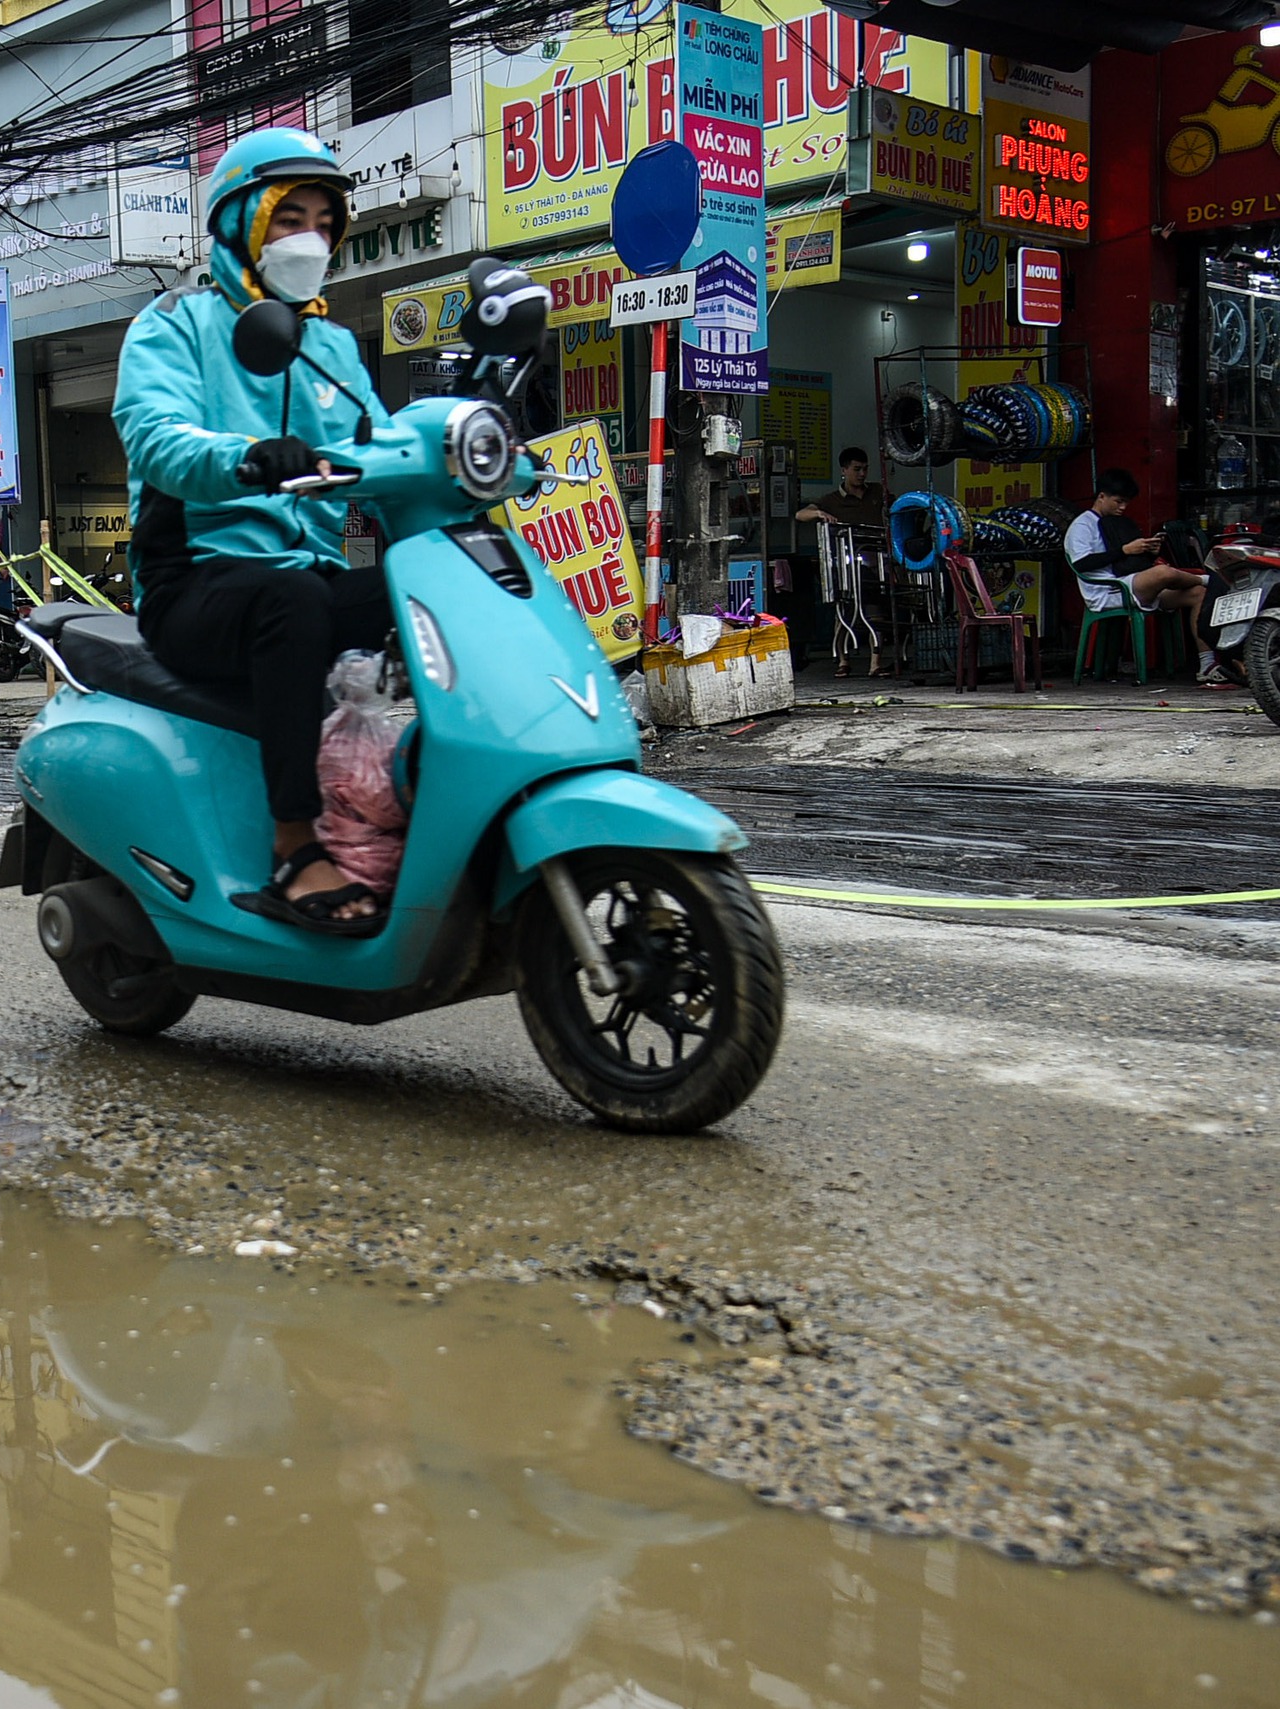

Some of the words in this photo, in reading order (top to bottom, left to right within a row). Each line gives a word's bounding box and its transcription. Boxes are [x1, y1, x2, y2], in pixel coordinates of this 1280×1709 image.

[704, 21, 722, 38] TIÊM
[723, 26, 750, 44] CHỦNG
[705, 39, 732, 58] LONG
[733, 46, 759, 65] CHÂU
[1009, 66, 1054, 90] ADVANCE
[683, 78, 726, 113] MIỄN
[730, 93, 759, 120] PHÍ
[501, 64, 627, 196] BÚN
[906, 105, 940, 137] Bé
[942, 114, 969, 145] út
[1028, 119, 1067, 143] SALON
[694, 123, 725, 152] VẮC
[727, 134, 751, 157] XIN
[375, 163, 387, 179] Y
[731, 166, 760, 188] LAO
[876, 136, 912, 184] BÚN
[915, 144, 937, 189] BÒ
[941, 151, 975, 198] HUẾ
[123, 188, 163, 213] CHÁNH
[164, 192, 189, 215] TÂM
[514, 204, 524, 215] 95
[524, 199, 535, 213] LÝ
[536, 194, 554, 209] THÁI
[572, 188, 584, 201] ĐÀ
[709, 196, 723, 212] trẻ
[725, 200, 736, 213] sơ
[737, 201, 757, 217] sinh
[999, 183, 1090, 231] HOÀNG
[1187, 203, 1224, 223] ĐC:
[1231, 198, 1256, 217] 97
[91, 212, 103, 235] &
[532, 205, 590, 228] 0357993143
[384, 222, 402, 256] Y
[12, 275, 33, 297] THÁI
[65, 265, 96, 284] THANH
[1025, 264, 1058, 280] MOTUL
[549, 265, 624, 312] BÚN
[616, 290, 646, 314] 16:30
[657, 284, 689, 308] 18:30
[961, 290, 1004, 359] BÚN
[694, 358, 710, 373] 125
[711, 359, 723, 378] Lý
[723, 360, 744, 376] Thái
[745, 360, 757, 377] Tổ
[564, 358, 596, 415] BÚN
[597, 351, 619, 411] BÒ
[565, 436, 603, 487] út
[69, 516, 93, 532] JUST
[95, 513, 127, 533] ENJOY
[521, 505, 587, 568] BÚN
[581, 484, 624, 550] BÒ
